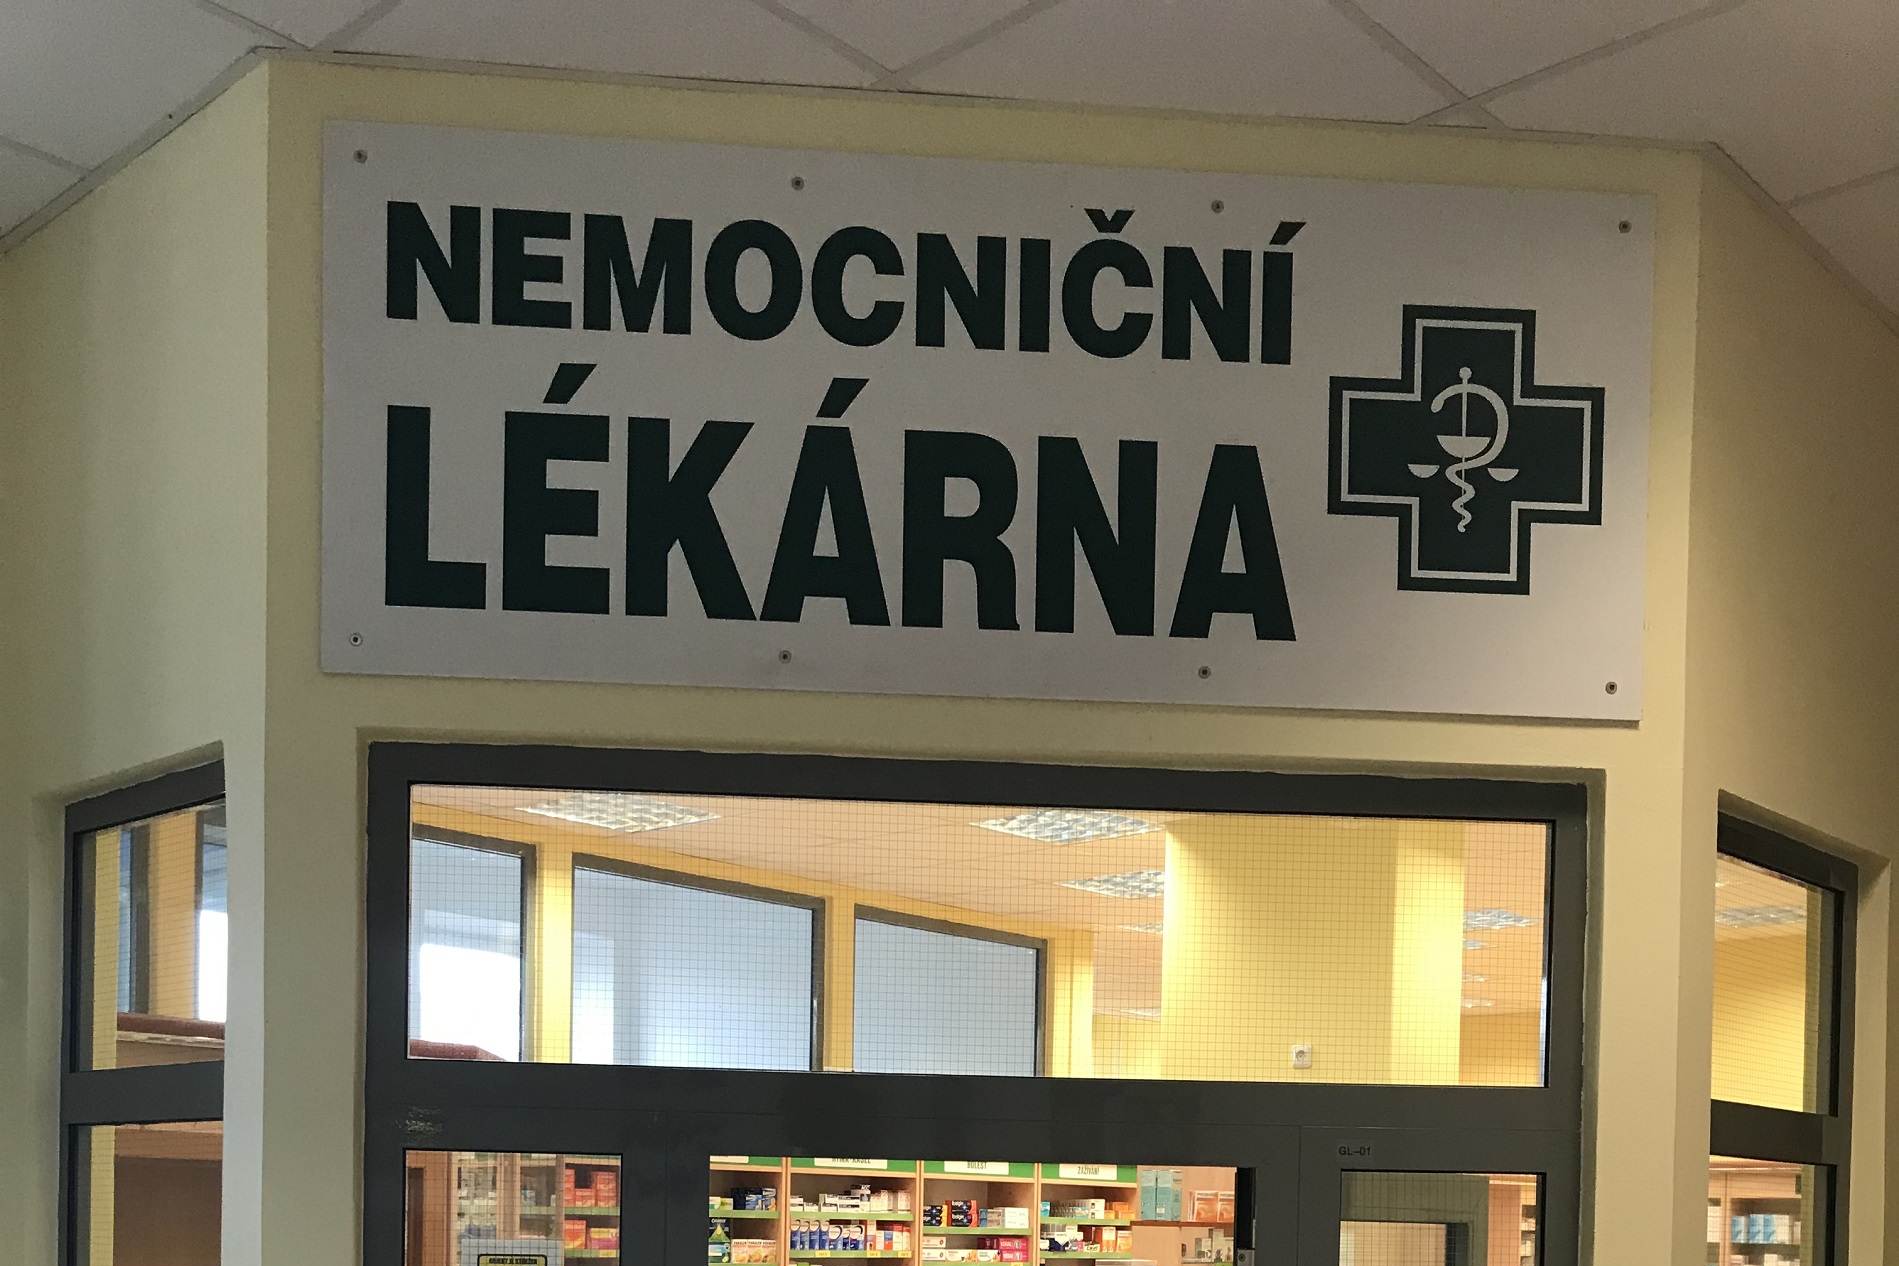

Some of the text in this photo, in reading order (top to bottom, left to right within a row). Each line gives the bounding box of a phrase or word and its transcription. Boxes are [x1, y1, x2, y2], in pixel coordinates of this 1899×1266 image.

[385, 200, 1306, 366] NEMOCNIČNÍ
[384, 362, 1297, 642] LÉKÁRNA
[1338, 1146, 1371, 1156] GL-01
